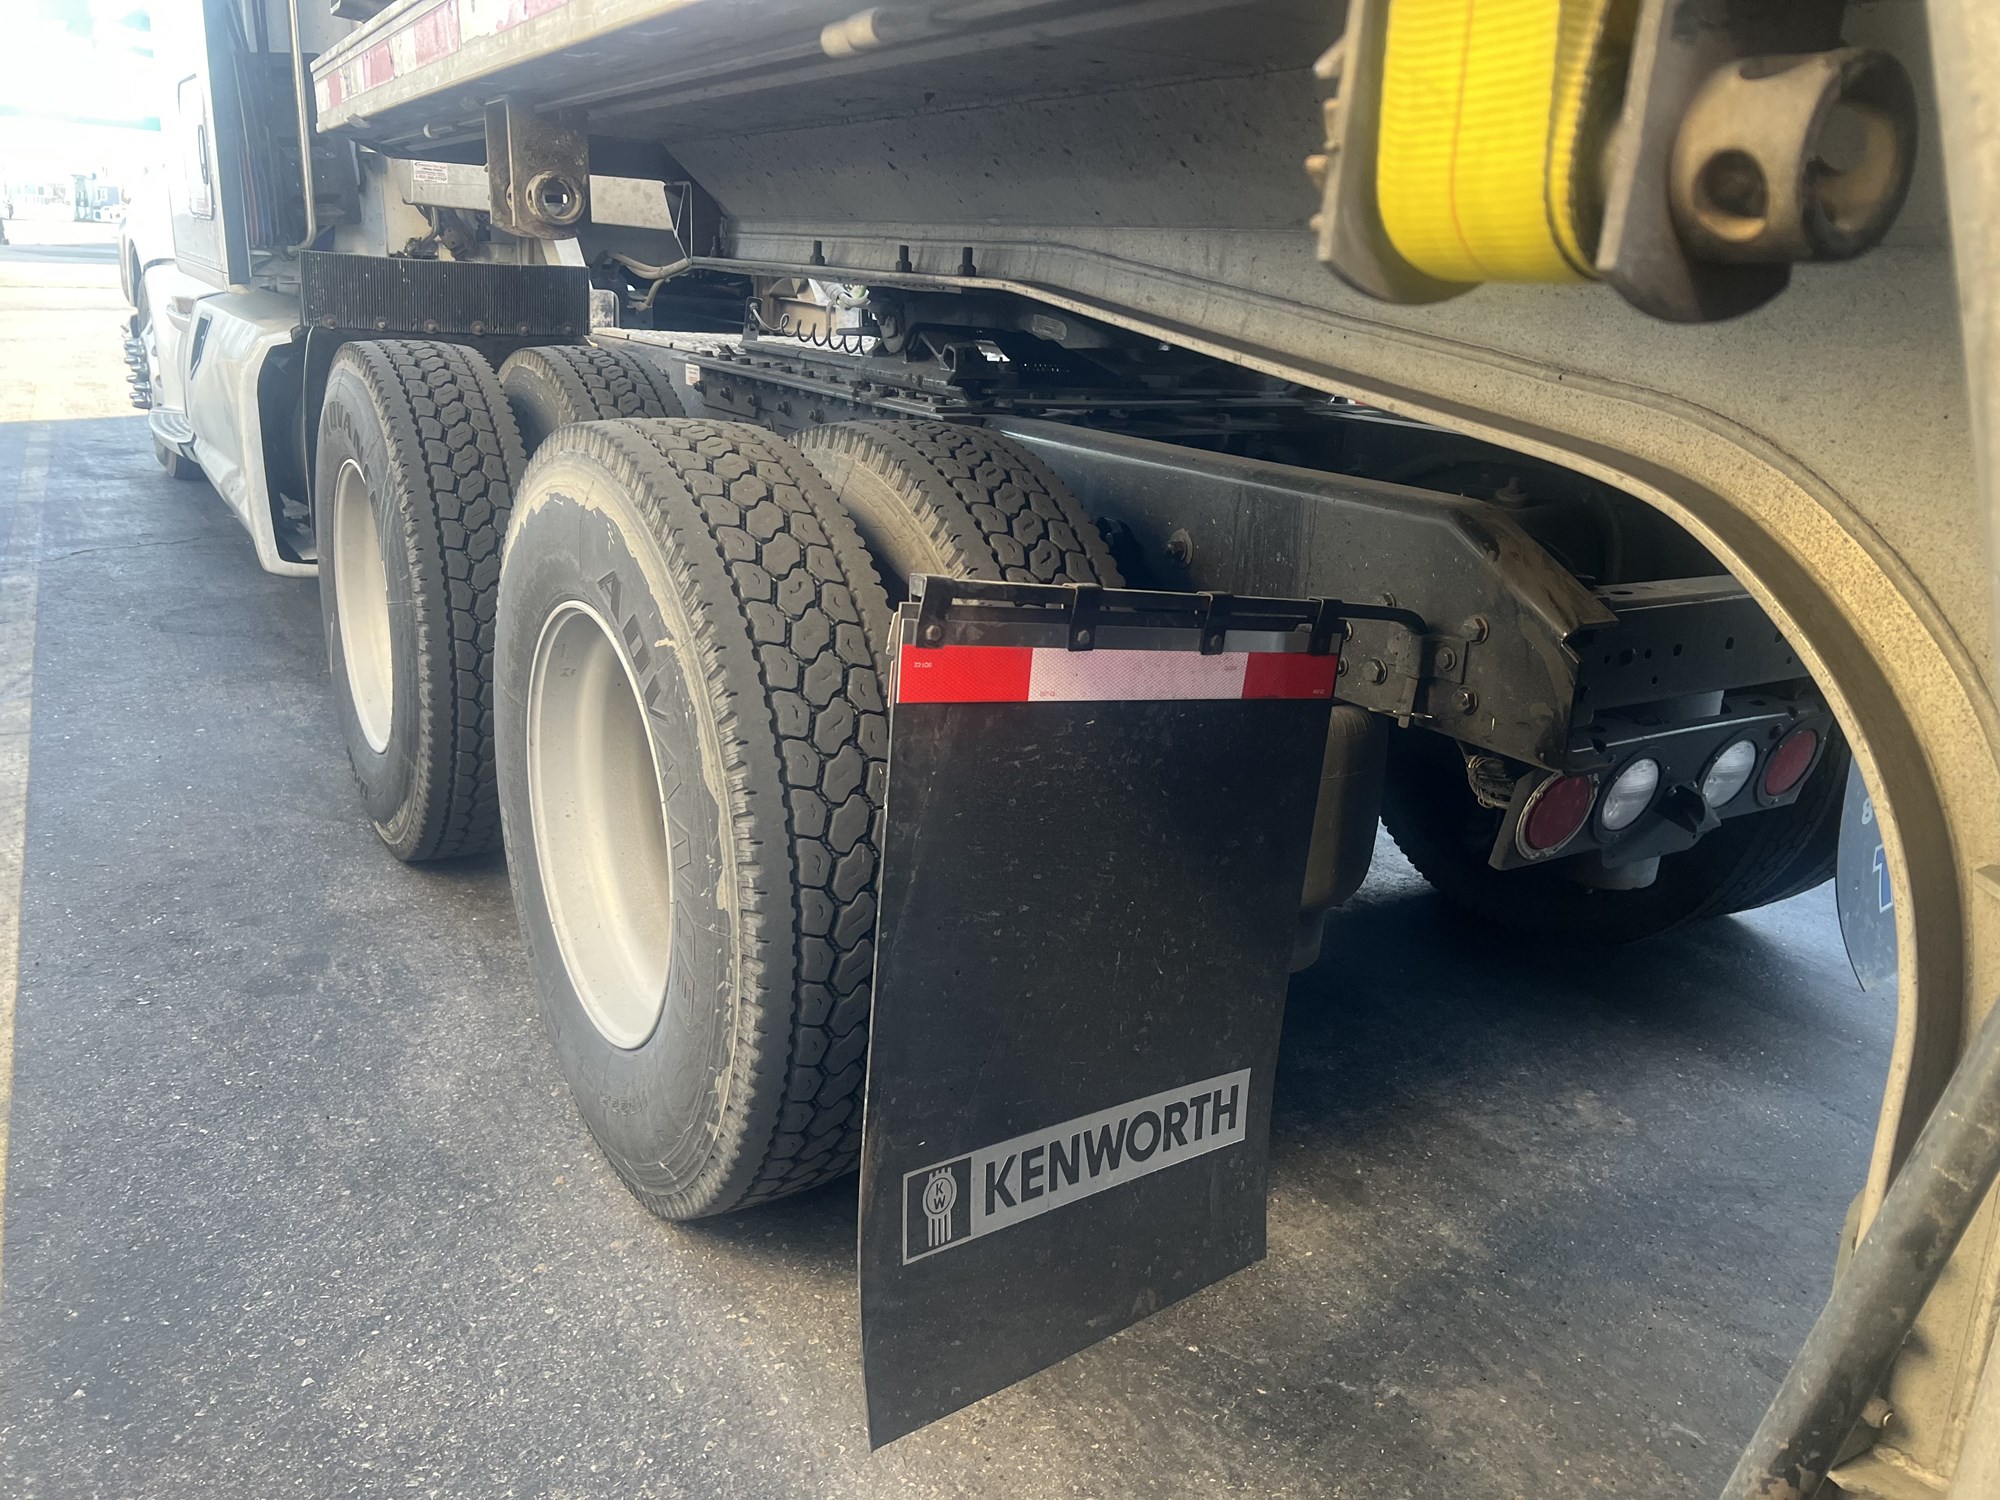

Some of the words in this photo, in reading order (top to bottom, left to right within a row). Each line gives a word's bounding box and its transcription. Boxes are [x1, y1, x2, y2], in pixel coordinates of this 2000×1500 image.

[322, 398, 382, 522] ADVANCE
[597, 570, 698, 1016] ADVANCE
[985, 1084, 1240, 1217] KENWORTH
